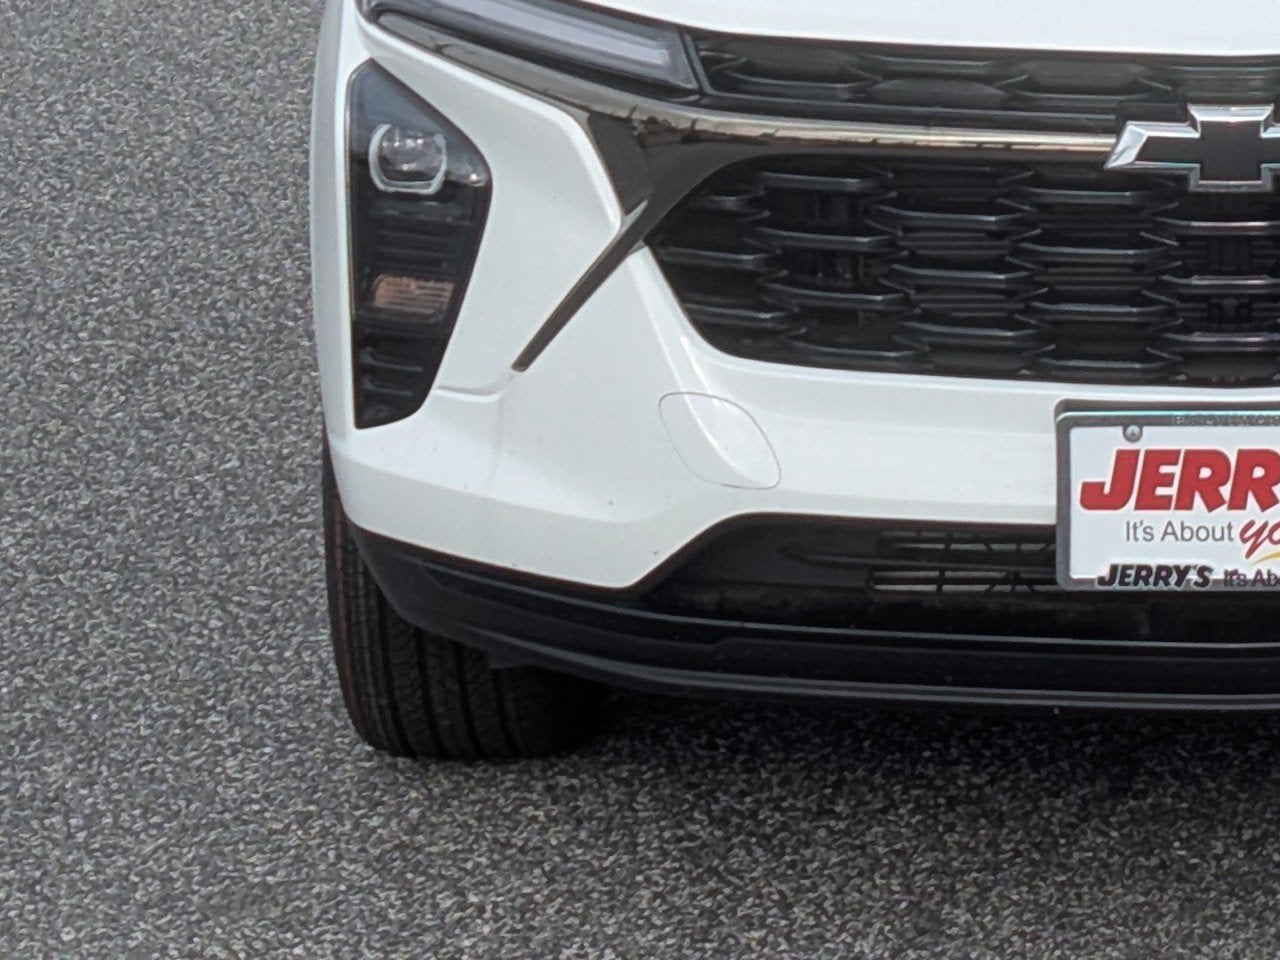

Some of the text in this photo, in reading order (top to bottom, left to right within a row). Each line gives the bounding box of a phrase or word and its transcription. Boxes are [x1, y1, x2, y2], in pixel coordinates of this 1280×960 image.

[1126, 520, 1154, 542] It's
[1162, 520, 1233, 542] About
[1098, 564, 1213, 587] JERRY'S
[1223, 569, 1247, 587] It's
